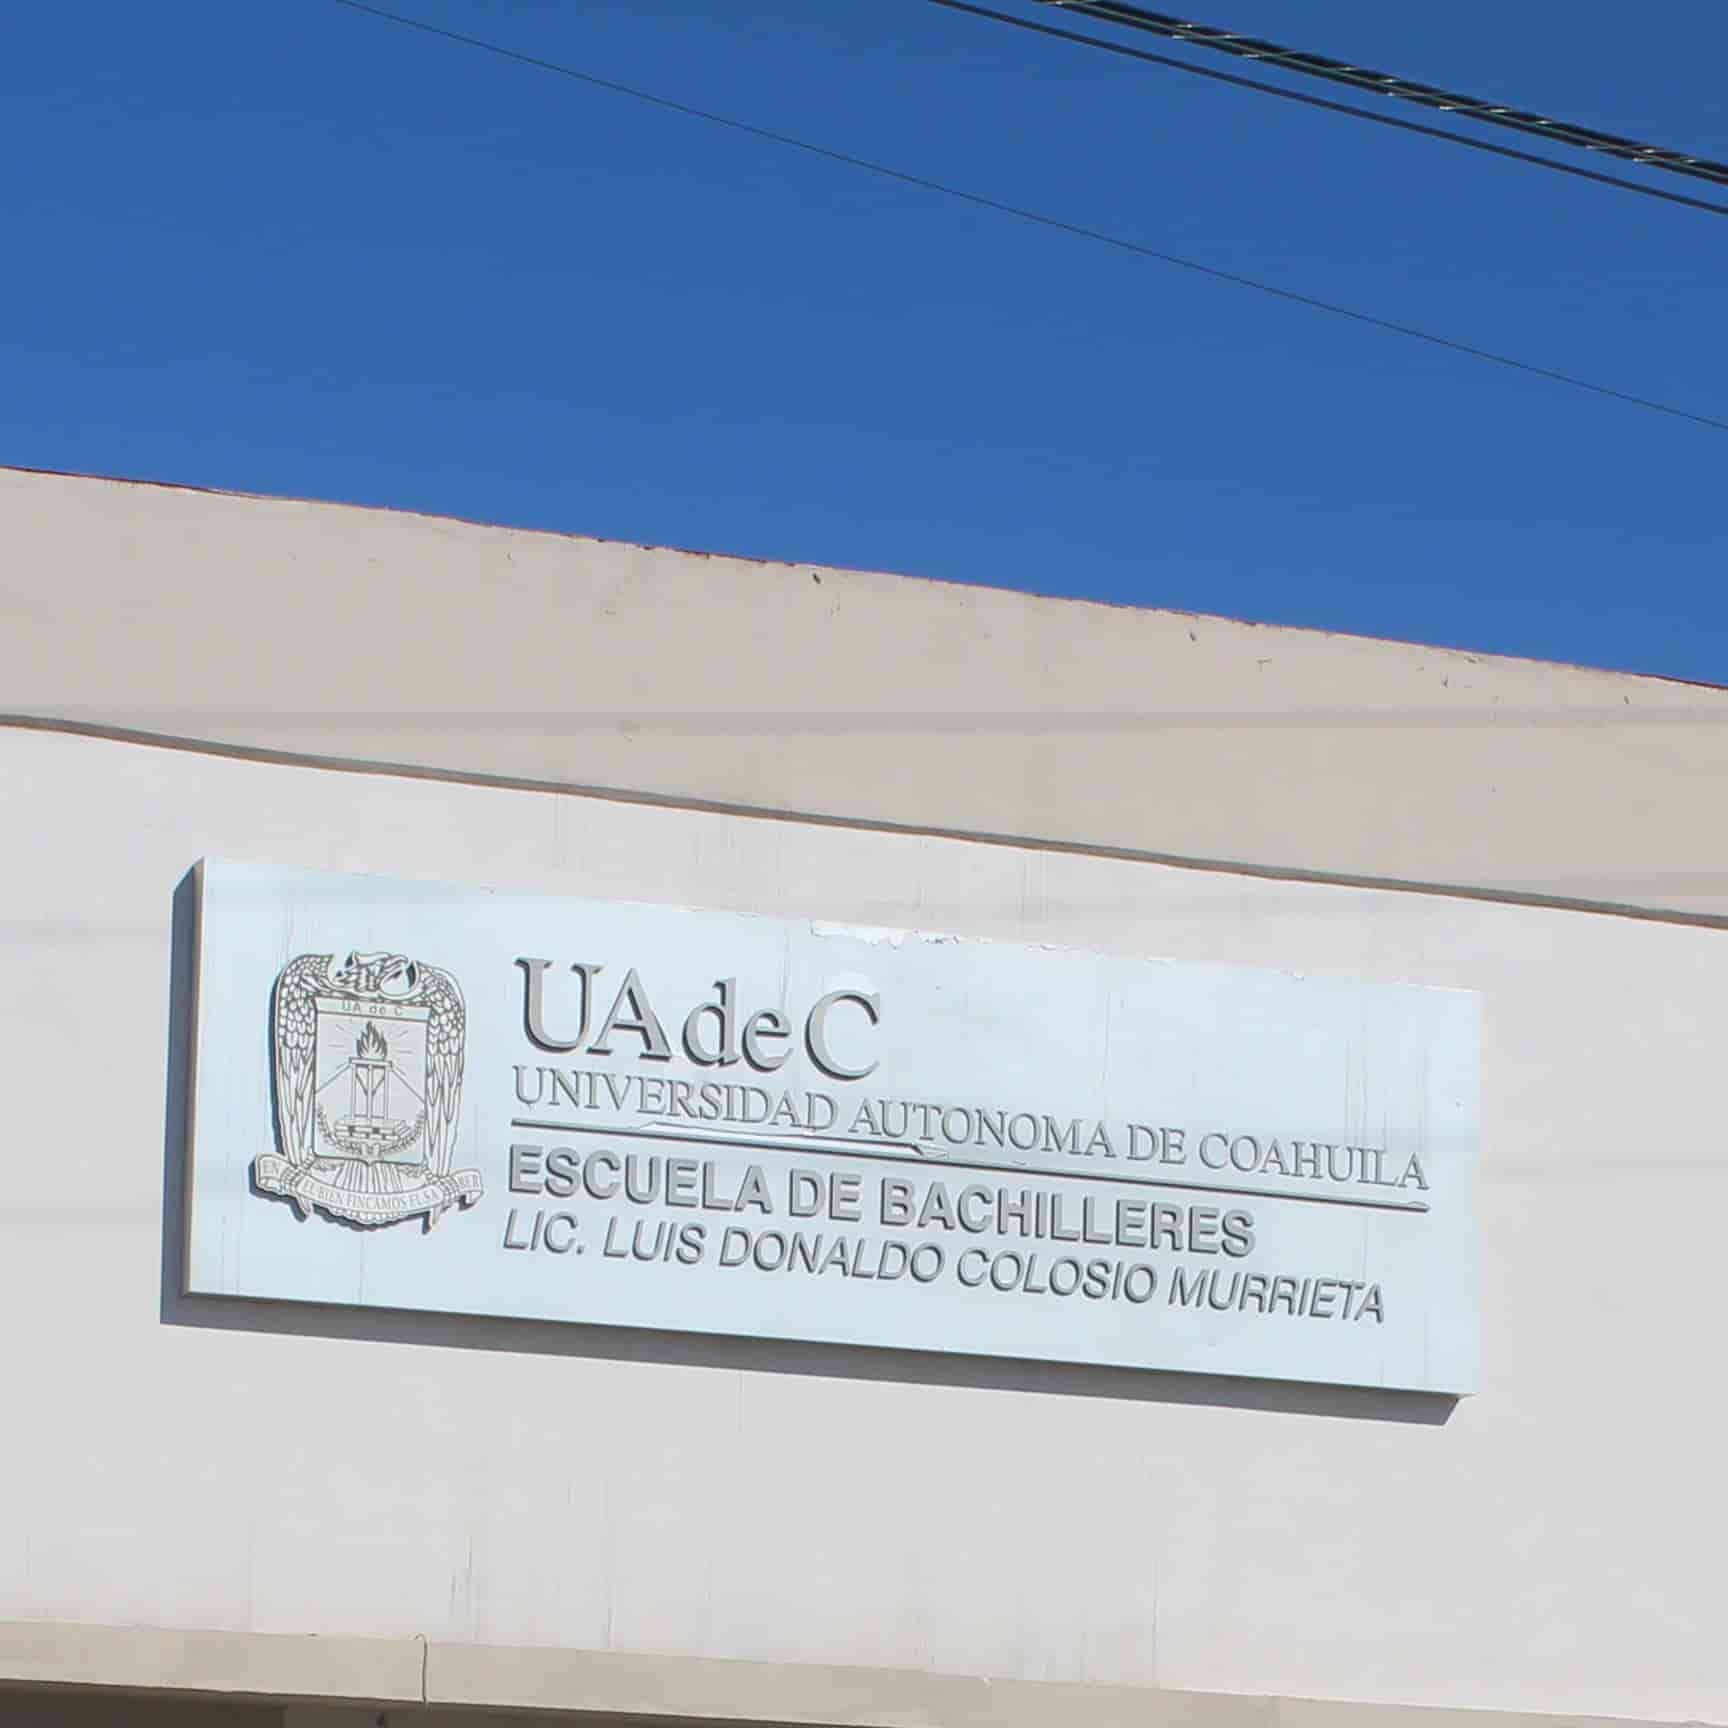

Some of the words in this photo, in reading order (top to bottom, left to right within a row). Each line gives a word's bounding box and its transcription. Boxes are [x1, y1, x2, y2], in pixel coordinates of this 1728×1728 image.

[513, 1065, 841, 1132] UNIVERSIDAD
[849, 1098, 1117, 1160] AUTONOMA
[1127, 1123, 1189, 1166] DE
[1199, 1132, 1430, 1191] COAHUILA
[508, 1142, 774, 1215] ESCUELA
[788, 1168, 864, 1223] DE
[879, 1177, 1257, 1258] BACHILLERES
[503, 1208, 586, 1255] LIC.
[603, 1215, 708, 1266] LUIS
[719, 1225, 946, 1284] DONALDO
[956, 1247, 1157, 1304] COLOSIO
[1166, 1264, 1386, 1324] MURRIETA
